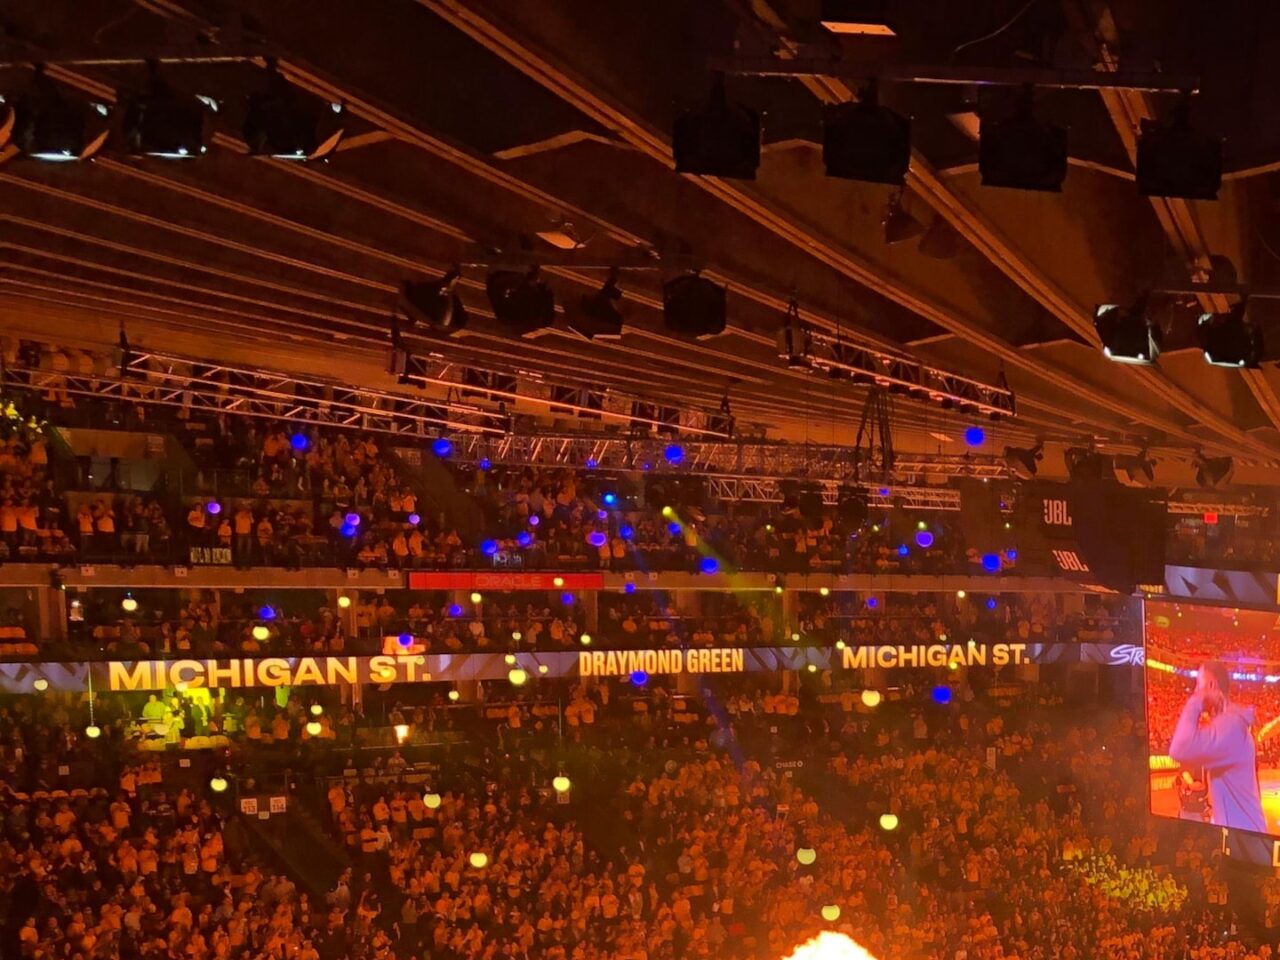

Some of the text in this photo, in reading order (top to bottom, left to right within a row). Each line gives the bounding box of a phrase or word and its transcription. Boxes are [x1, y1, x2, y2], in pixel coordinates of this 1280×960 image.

[1043, 499, 1072, 525] JBL
[1052, 550, 1089, 572] JBL
[475, 575, 542, 588] ORACLE
[579, 648, 744, 677] DRAYMOND GREEN
[842, 643, 1030, 669] MICHIGAN ST.
[108, 655, 432, 690] MICHIGAN ST.
